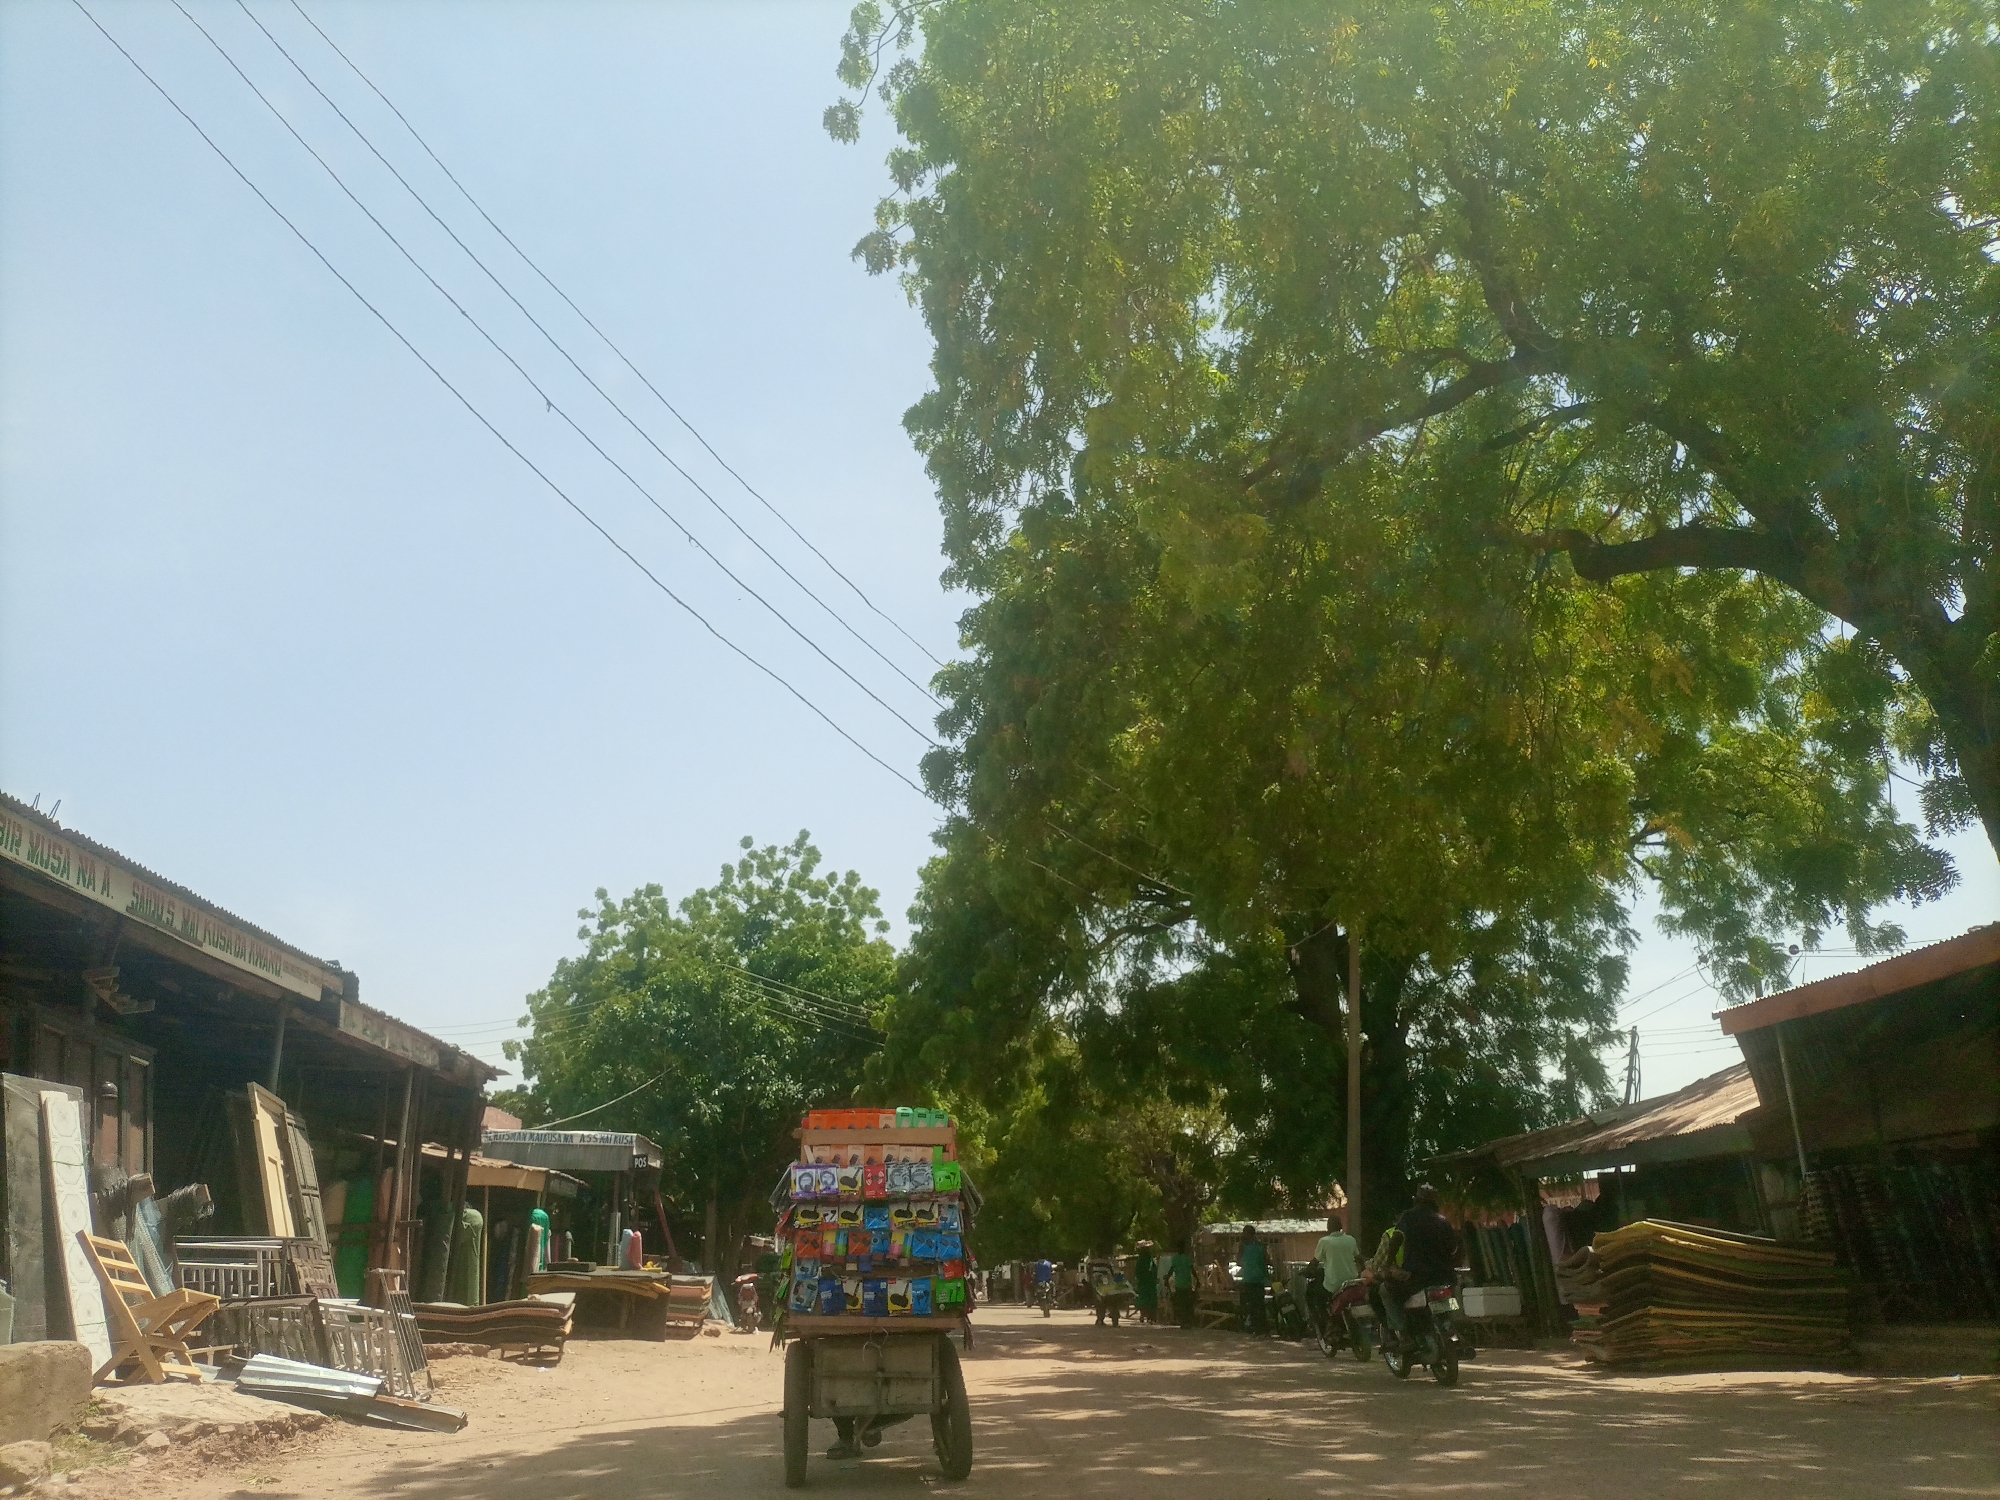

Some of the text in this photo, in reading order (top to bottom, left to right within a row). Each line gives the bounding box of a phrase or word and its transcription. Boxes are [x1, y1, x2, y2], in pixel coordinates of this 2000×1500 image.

[26, 829, 71, 881] MUSA
[76, 853, 96, 893] NA
[634, 1157, 648, 1169] POS
